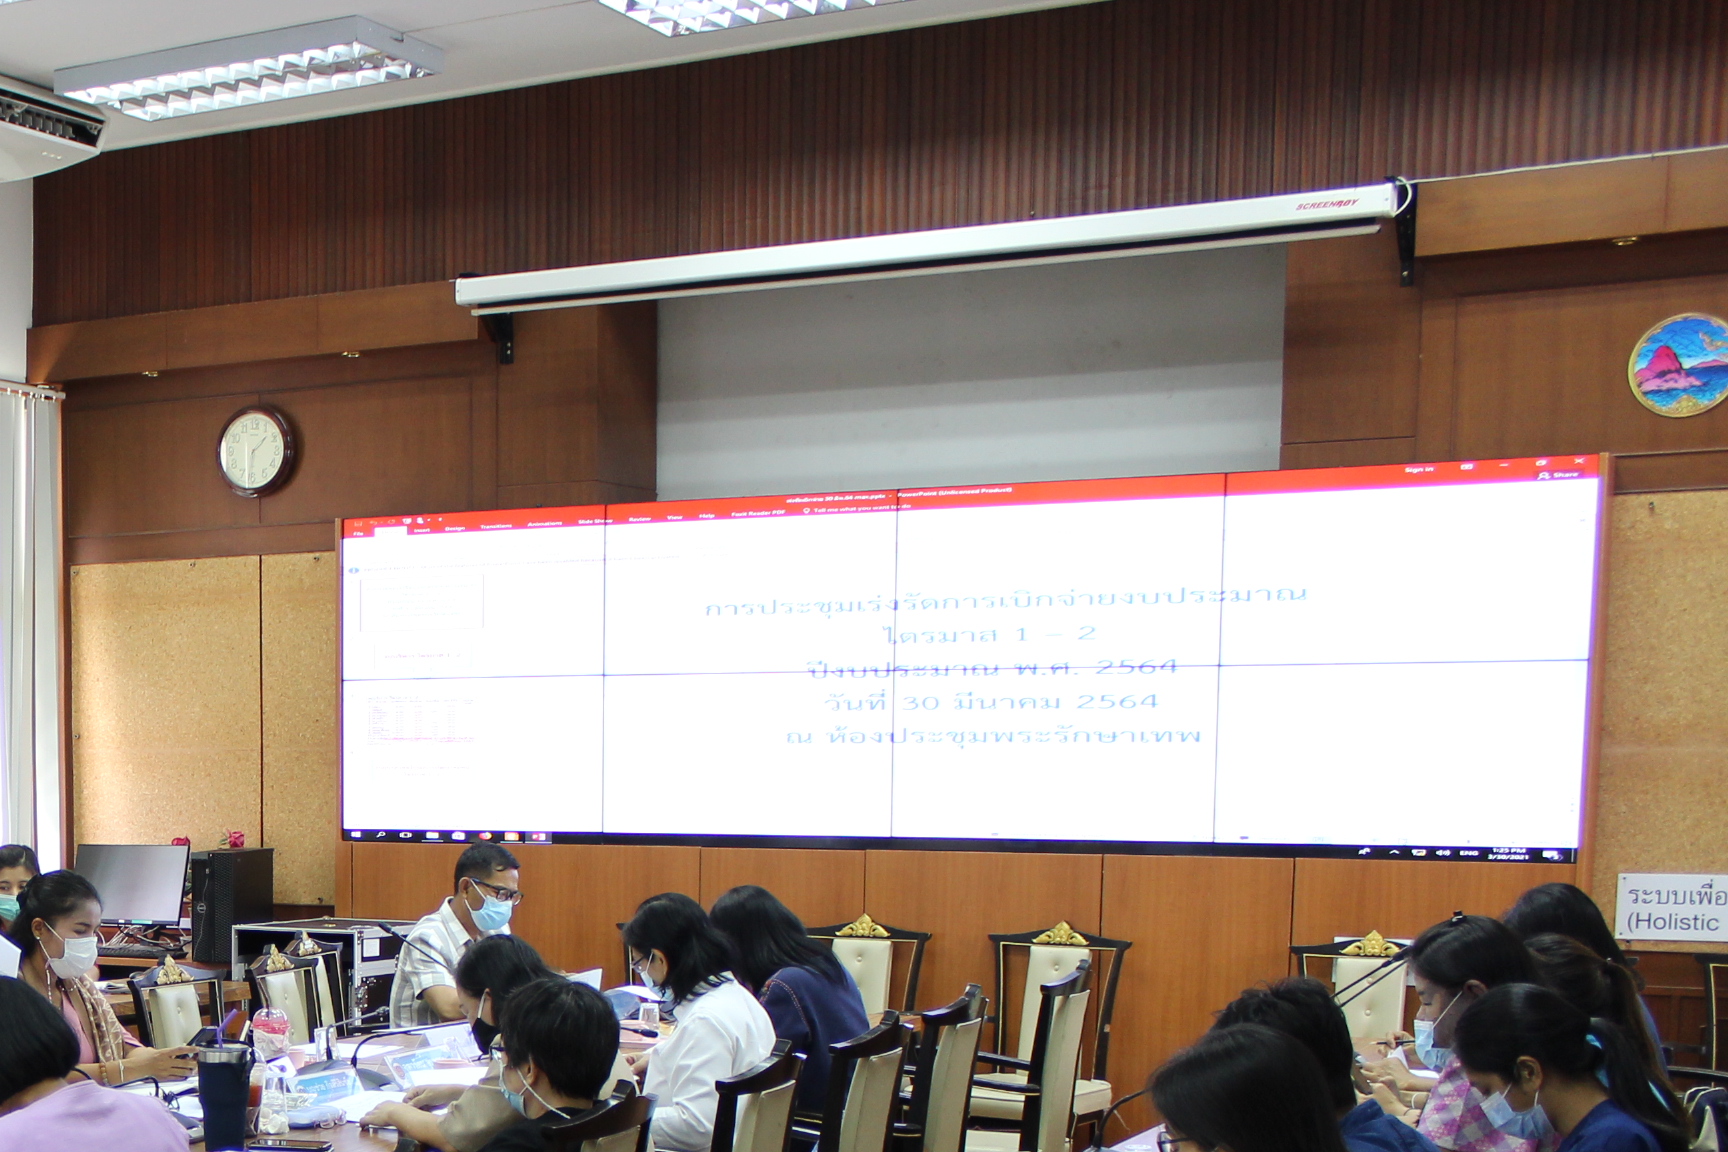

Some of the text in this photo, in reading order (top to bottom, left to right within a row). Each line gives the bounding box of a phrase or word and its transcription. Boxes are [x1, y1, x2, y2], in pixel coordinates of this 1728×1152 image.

[1404, 466, 1423, 474] Sign
[705, 587, 1308, 619] การประชุมเร่งรัดการเบิกจ่ายงบประมาณ
[882, 625, 998, 645] ไตรมาส
[1016, 627, 1028, 642] 1
[1077, 625, 1097, 640] 2
[806, 658, 1179, 679] ปีงบประมาณ พ.ศ. 2564
[824, 688, 1159, 712] วันที่ 30 มีนาคม 2564
[786, 724, 1202, 749] ณ ห้องประชุมพระรักษาเทพ
[1627, 912, 1720, 934] (Holistic
